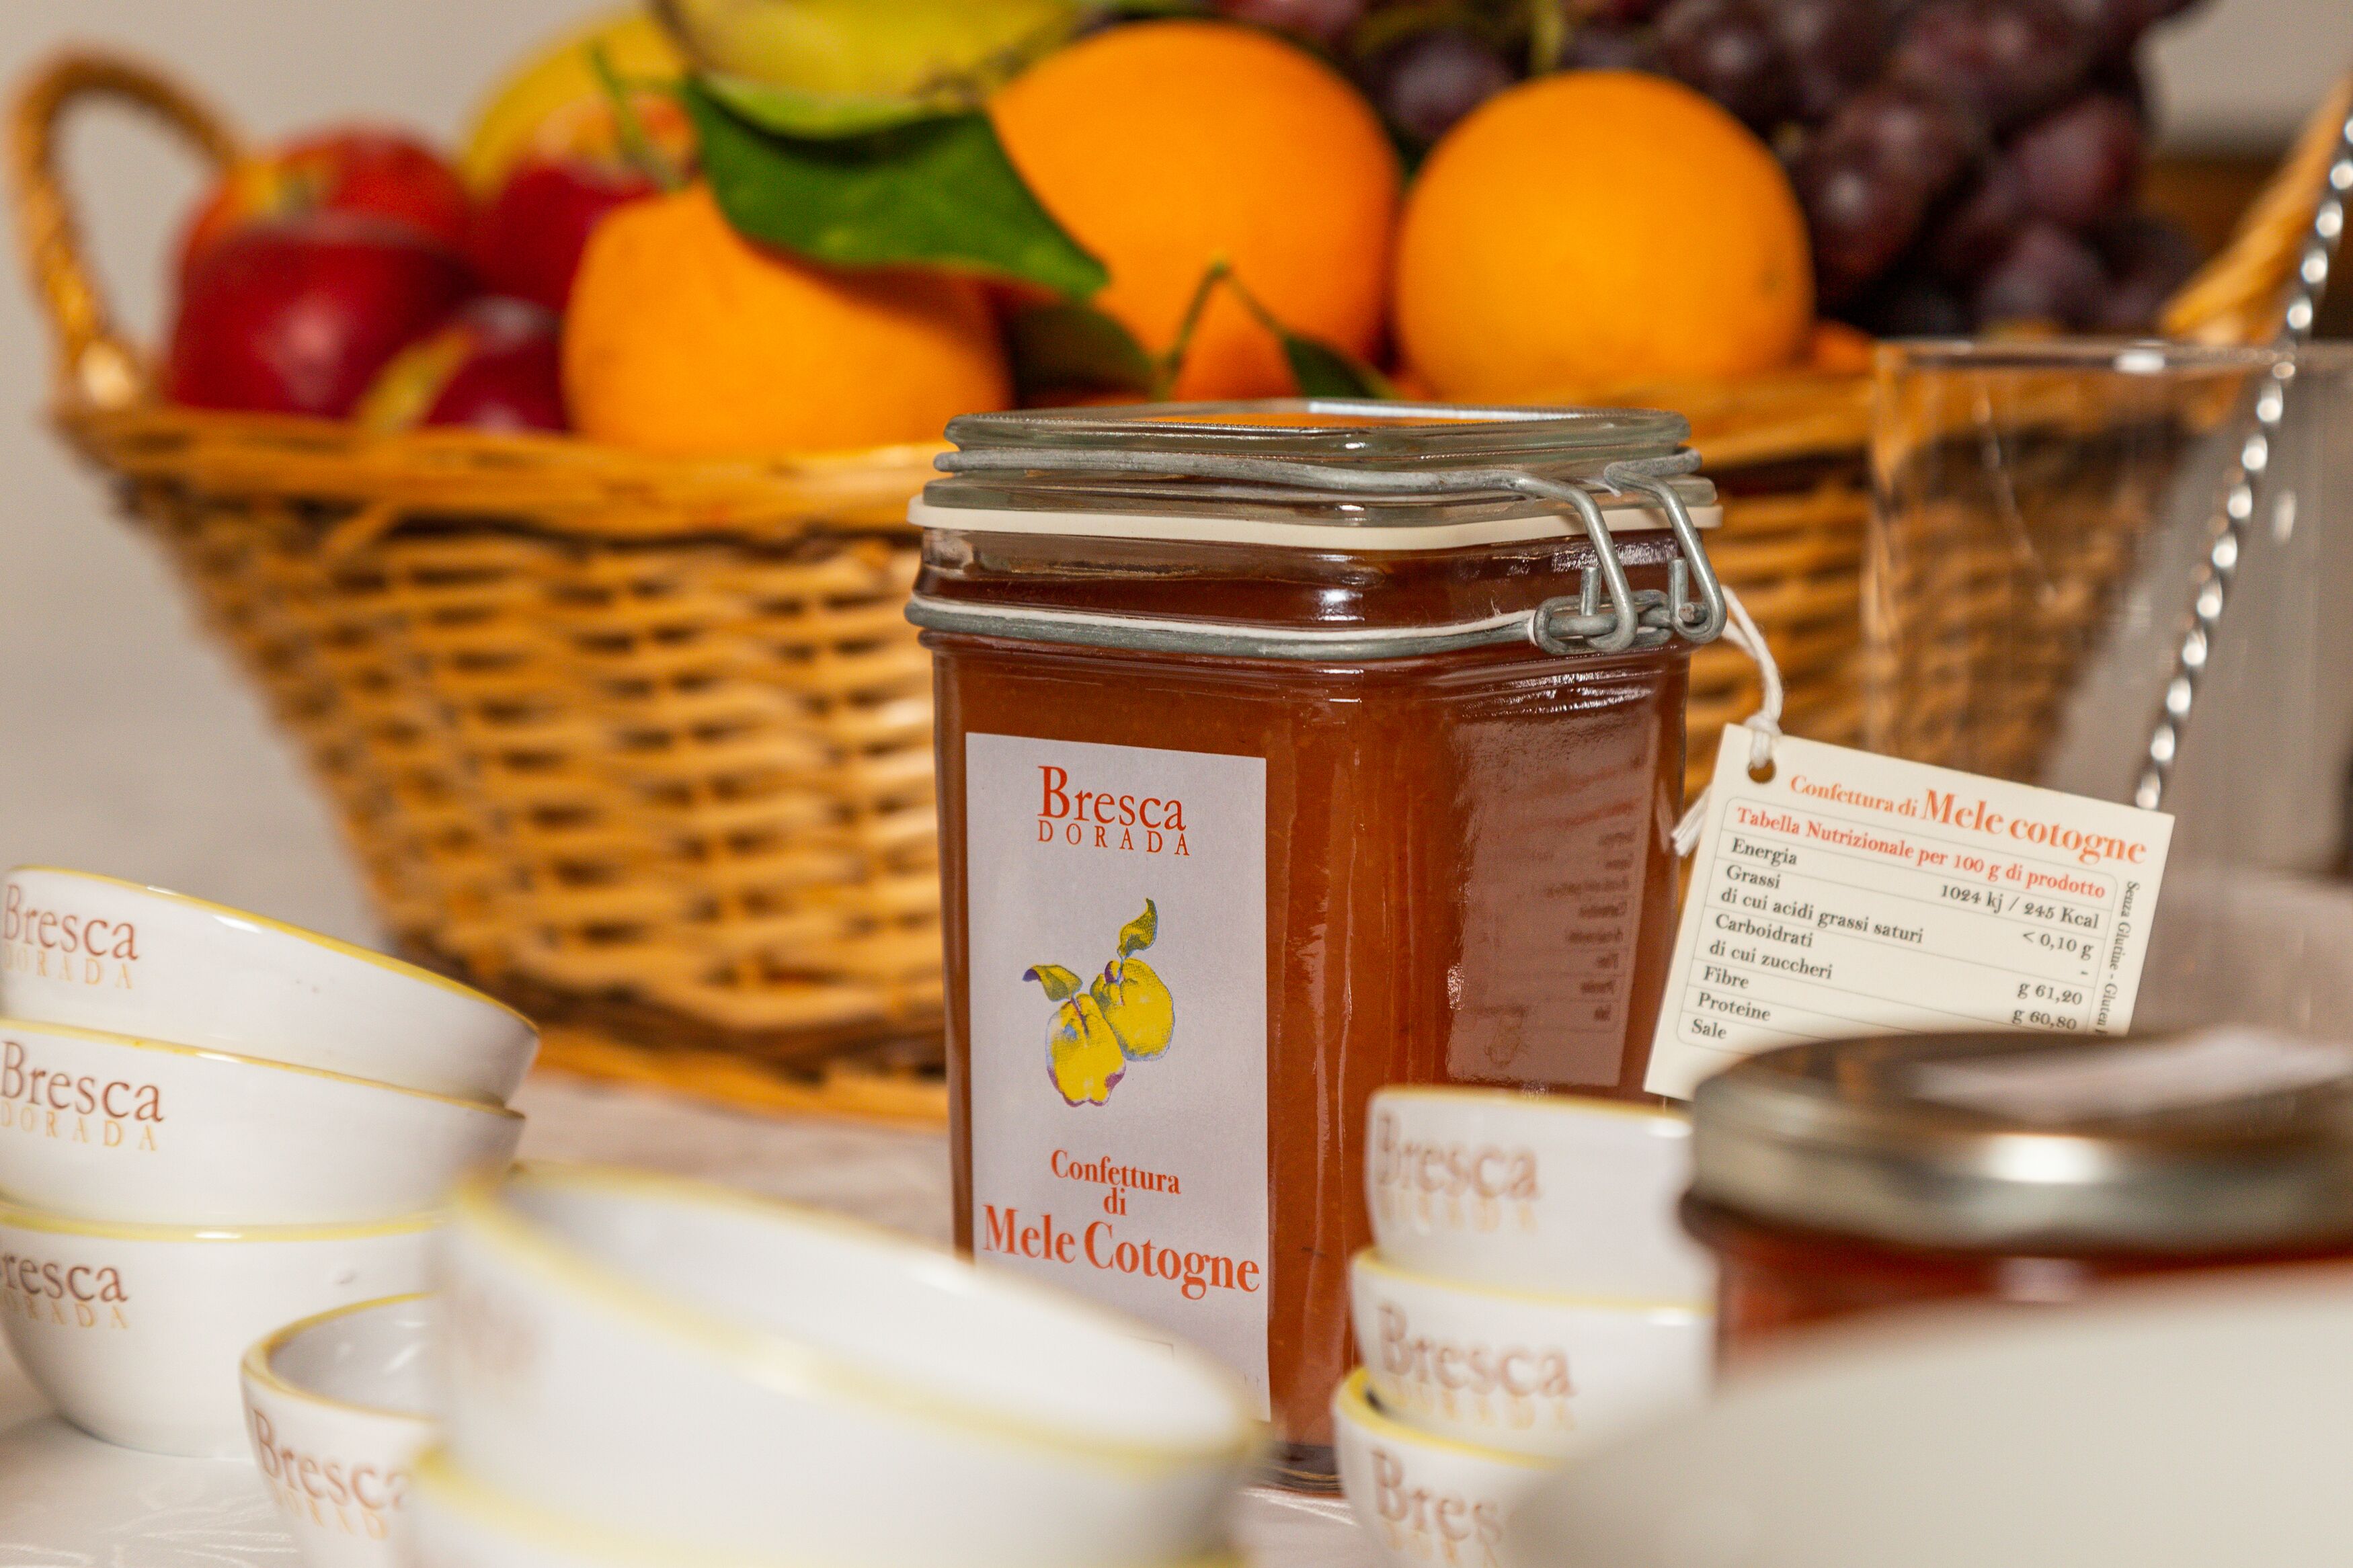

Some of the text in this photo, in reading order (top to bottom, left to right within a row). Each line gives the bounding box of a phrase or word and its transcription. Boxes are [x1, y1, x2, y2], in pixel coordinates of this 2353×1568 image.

[1037, 765, 1187, 831] Bresca
[1037, 819, 1191, 856] DORADA
[1790, 774, 2148, 866] Confettura di Mele cotogne
[1731, 837, 1798, 866] Energia
[1737, 807, 2106, 899] Tabella Nutrizionale per 100 g di prodotto
[1726, 864, 1781, 889] Grassi
[1721, 887, 1924, 944] di cui acidi grassi saturi
[1941, 884, 2100, 930] 1024 kj / 245 Kcal
[2120, 880, 2141, 917] Senza
[3, 884, 139, 962] Bresca
[1716, 913, 1814, 948] Carboidrati
[1710, 940, 1833, 980] di cui zuccheri
[2040, 933, 2077, 952] 0,10
[2081, 943, 2095, 961] g
[2109, 921, 2132, 971] Glutine
[1703, 965, 1749, 989] Fibre
[2018, 983, 2083, 1006] g 61,20
[1698, 991, 1771, 1022] Proteine
[2011, 1009, 2077, 1030] g 60,80
[2097, 983, 2118, 1026] Gluten
[1691, 1018, 1727, 1040] Sale
[1, 1041, 165, 1123] Bresca
[1051, 1149, 1182, 1195] Confettura
[1103, 1187, 1127, 1216] di
[982, 1204, 1261, 1301] Mele Cotogne
[0, 1253, 129, 1303] resca
[1370, 1446, 1506, 1544] Bres
